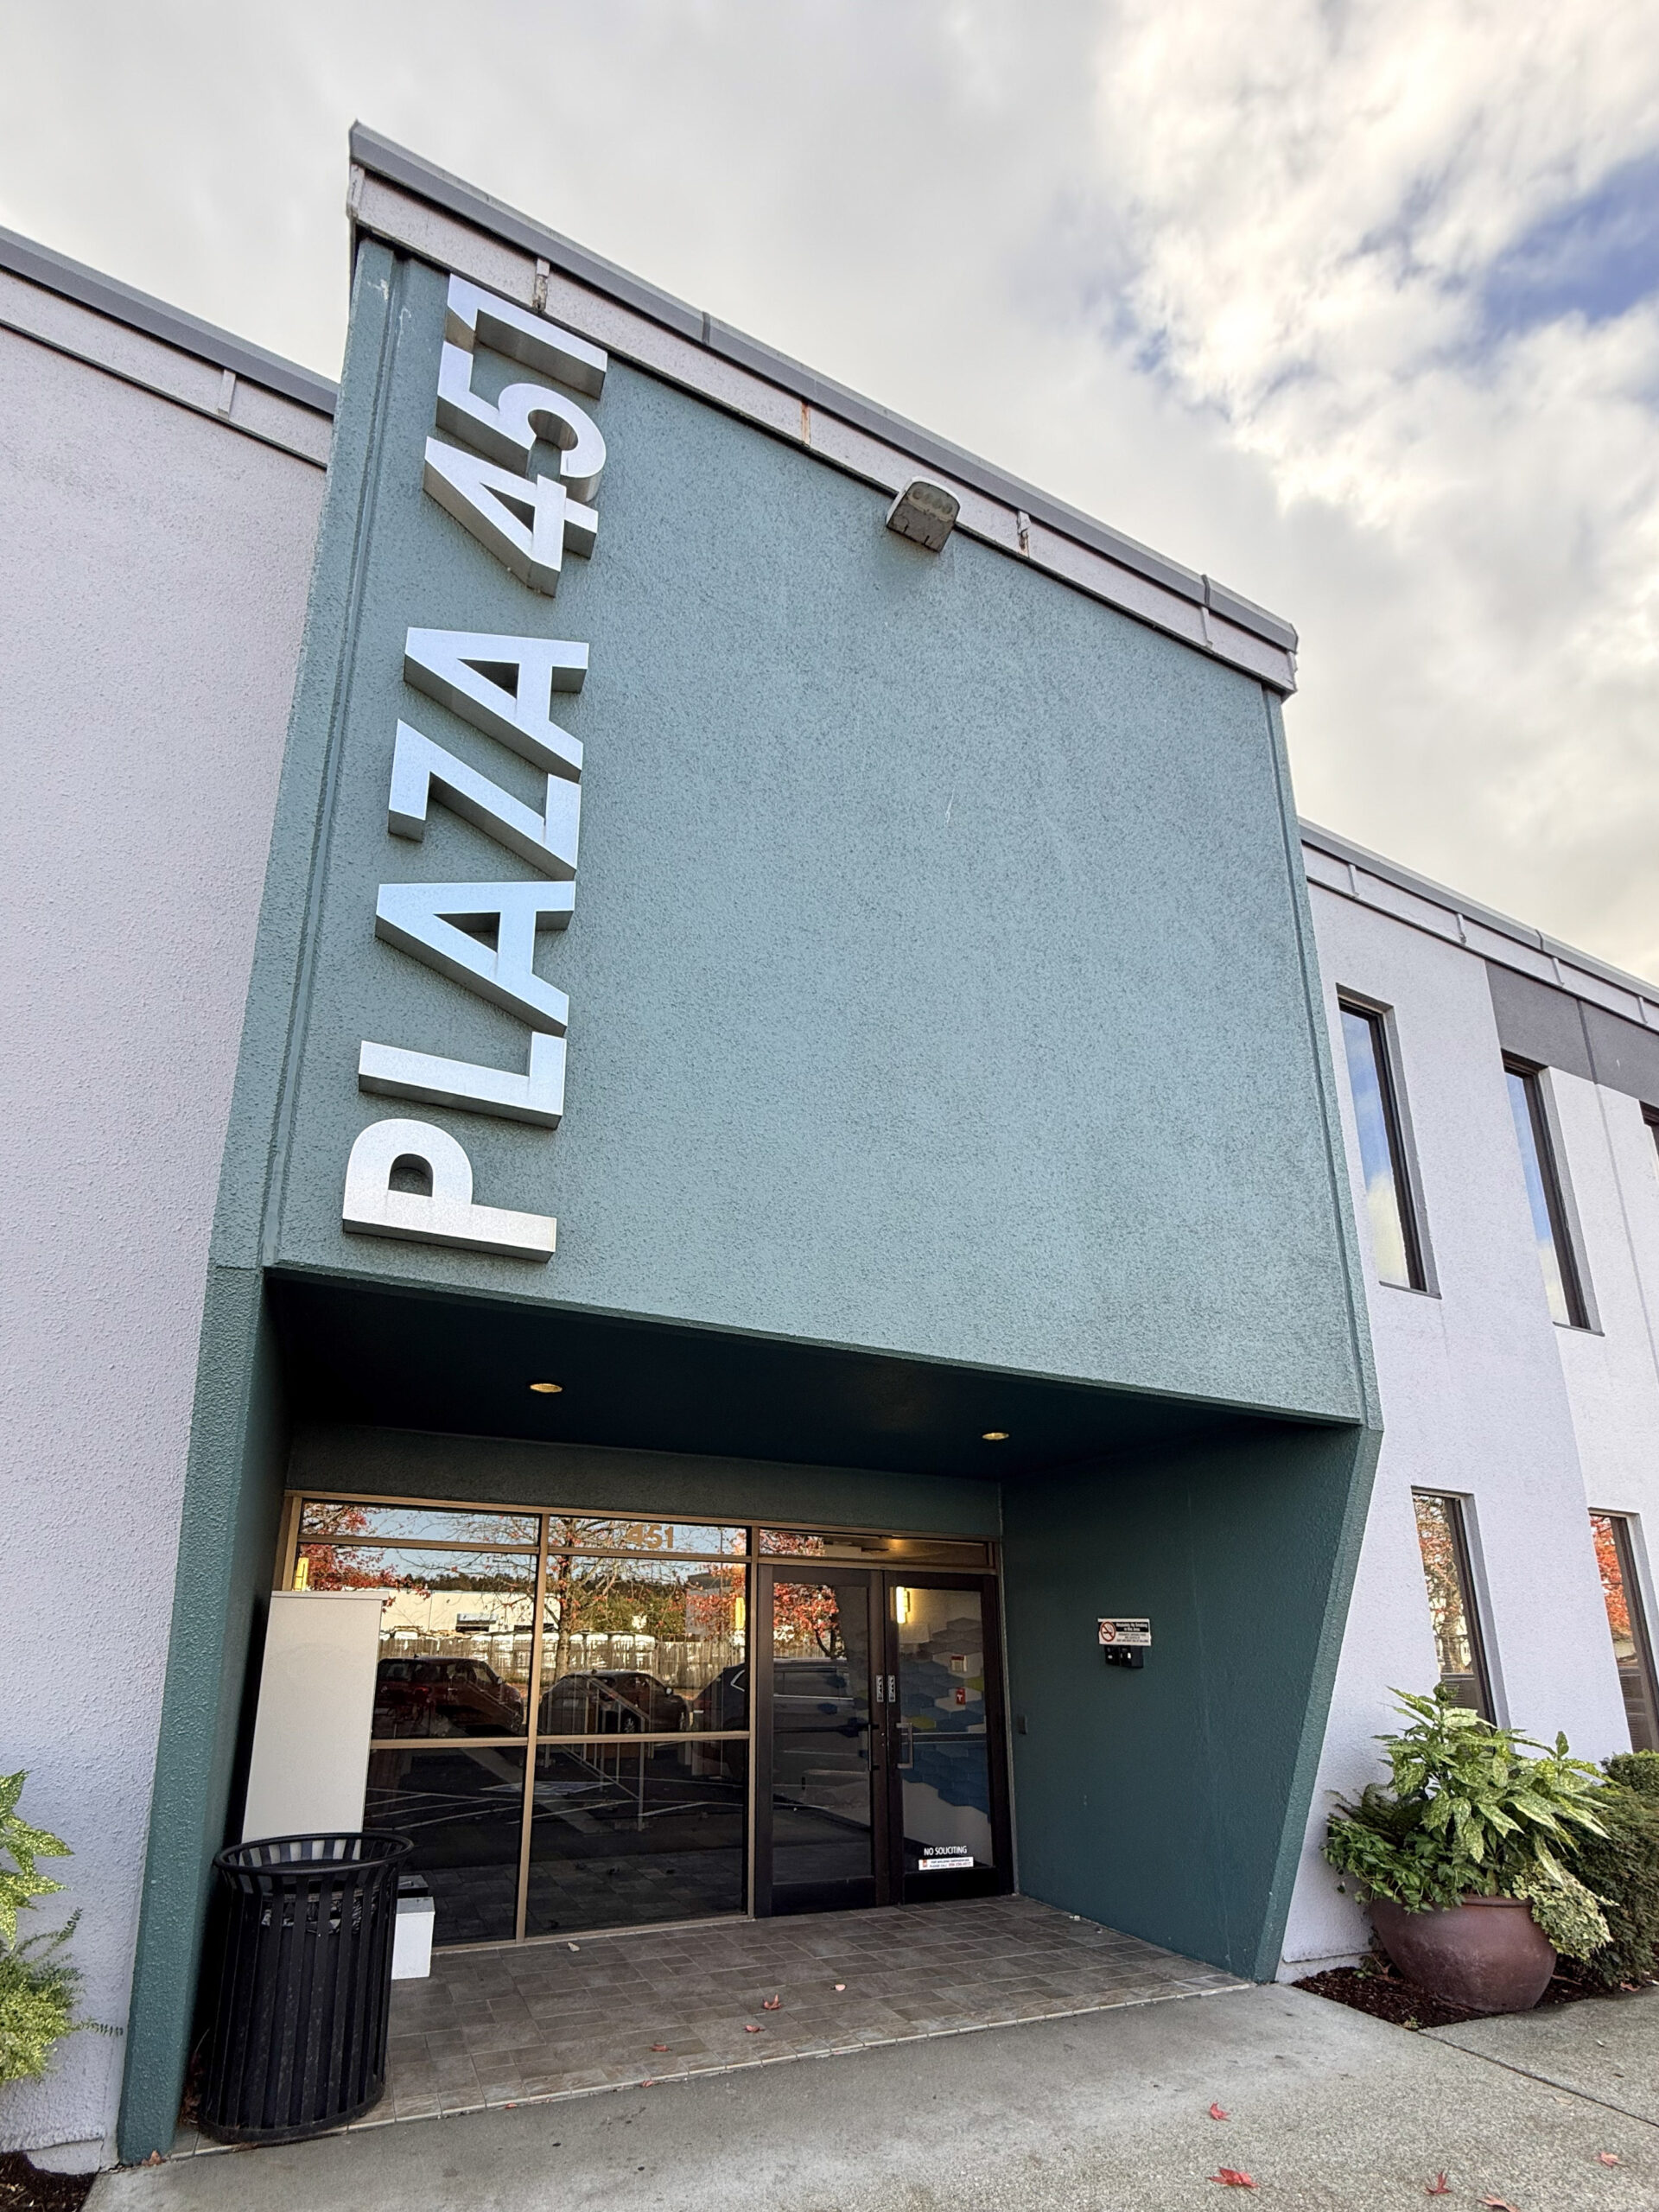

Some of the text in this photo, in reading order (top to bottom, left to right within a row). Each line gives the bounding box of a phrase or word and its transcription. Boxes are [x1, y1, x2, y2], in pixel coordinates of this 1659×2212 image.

[342, 273, 607, 1258] PLAZA 451
[626, 1523, 674, 1549] 451
[924, 1846, 967, 1856] NO SOLICITING
